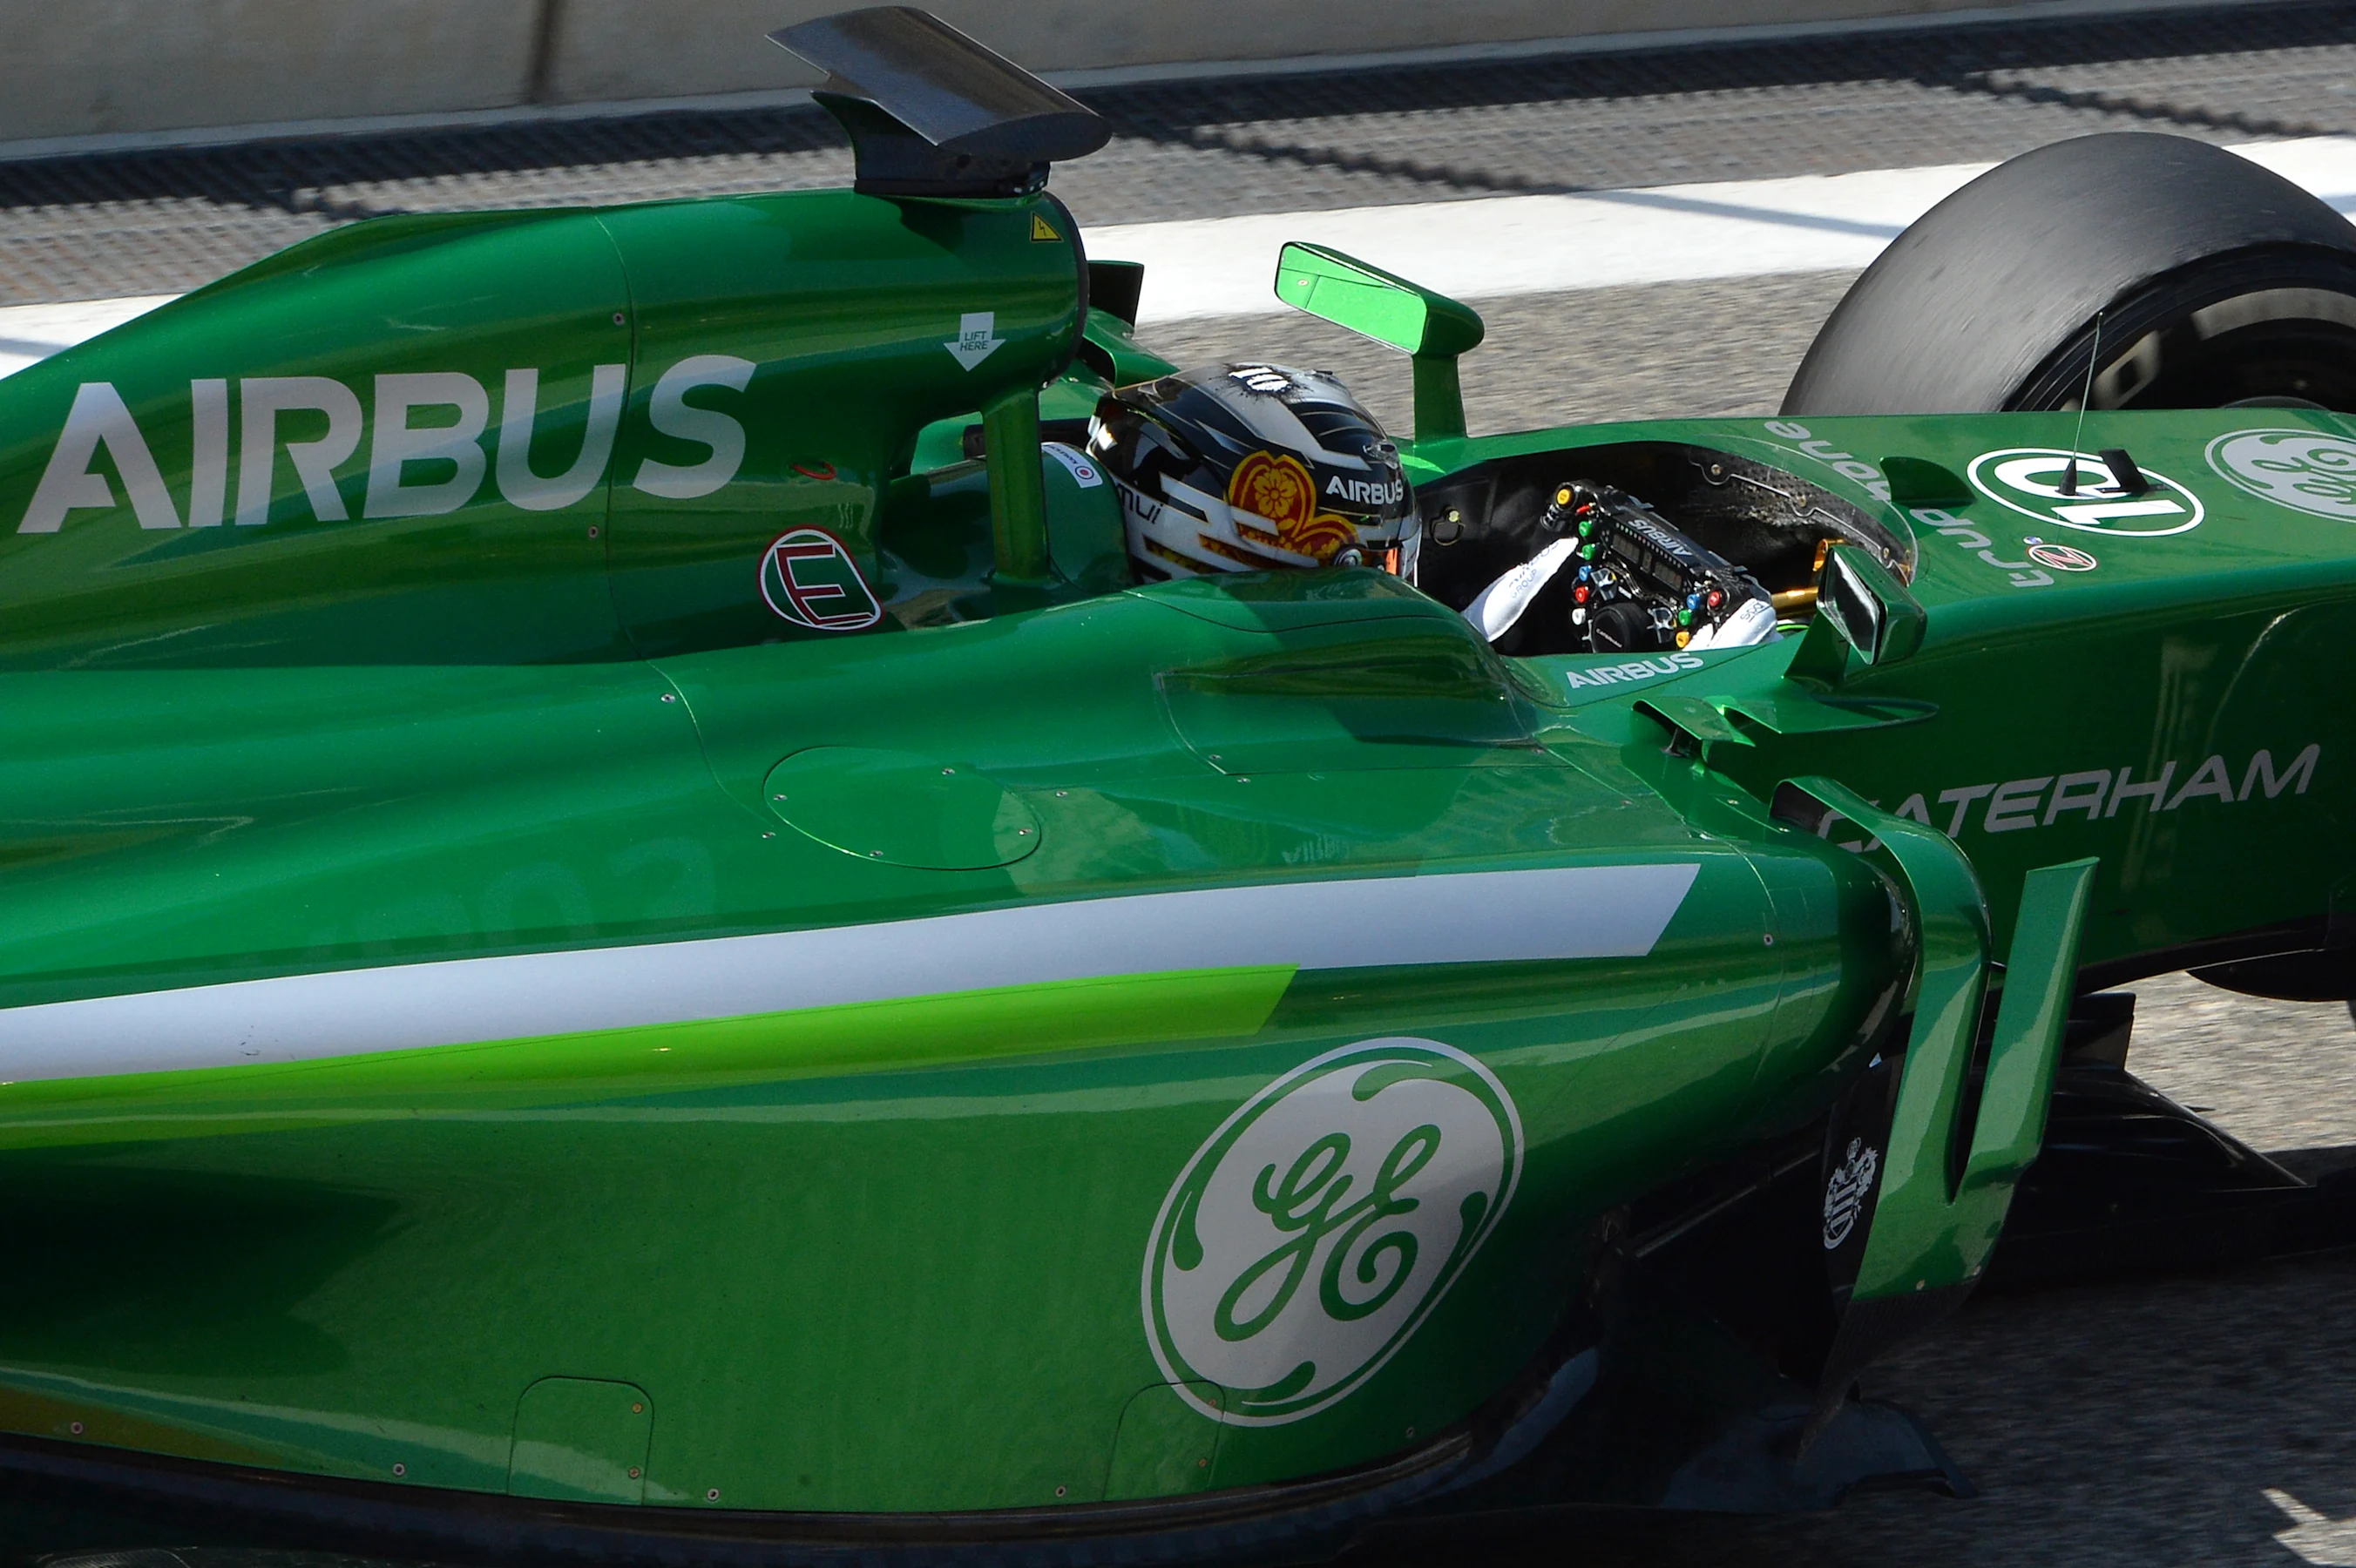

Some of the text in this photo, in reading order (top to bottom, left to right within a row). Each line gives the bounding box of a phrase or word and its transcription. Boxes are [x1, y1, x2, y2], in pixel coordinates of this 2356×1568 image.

[959, 341, 988, 351] HERE
[964, 331, 987, 341] LIFT
[17, 355, 756, 533] AIRBUS
[1325, 475, 1404, 505] AIRBUS
[1628, 519, 1692, 556] AIRBUS
[774, 540, 875, 627] E
[1566, 652, 1704, 689] AIRBUS
